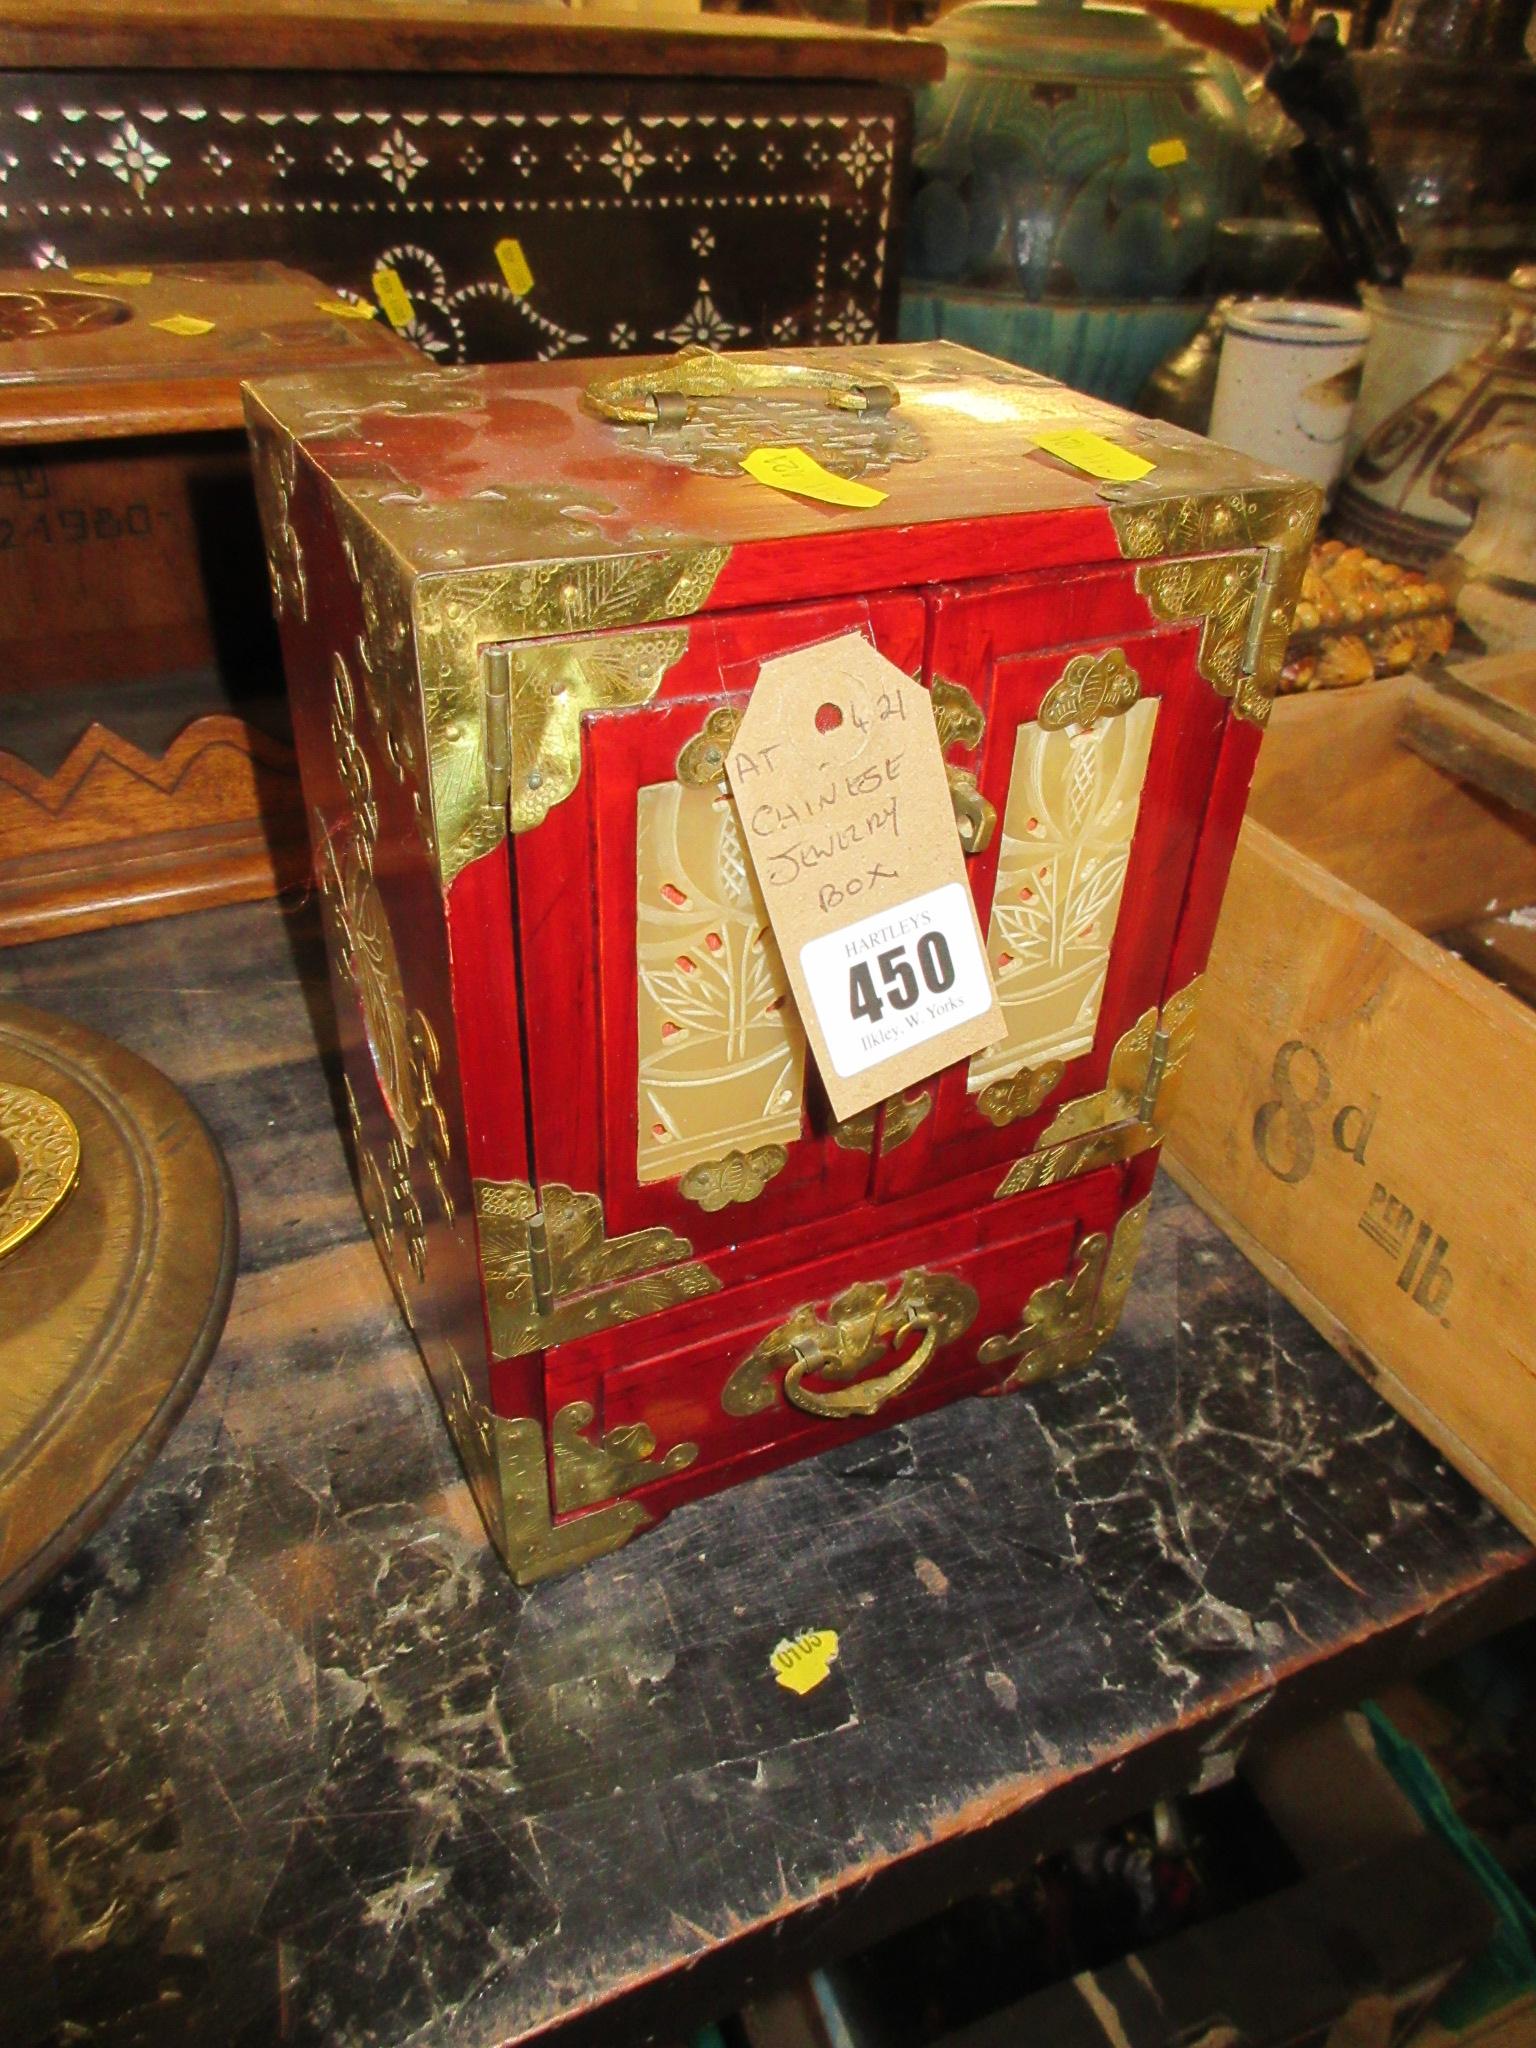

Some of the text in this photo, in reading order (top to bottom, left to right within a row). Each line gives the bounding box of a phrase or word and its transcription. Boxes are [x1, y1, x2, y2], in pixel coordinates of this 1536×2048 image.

[735, 744, 782, 784] AT
[752, 752, 905, 837] CHINESE
[818, 863, 899, 913] BOX
[844, 909, 933, 959] HARTLEYS
[849, 930, 956, 1024] 450
[926, 995, 966, 1021] Yorks
